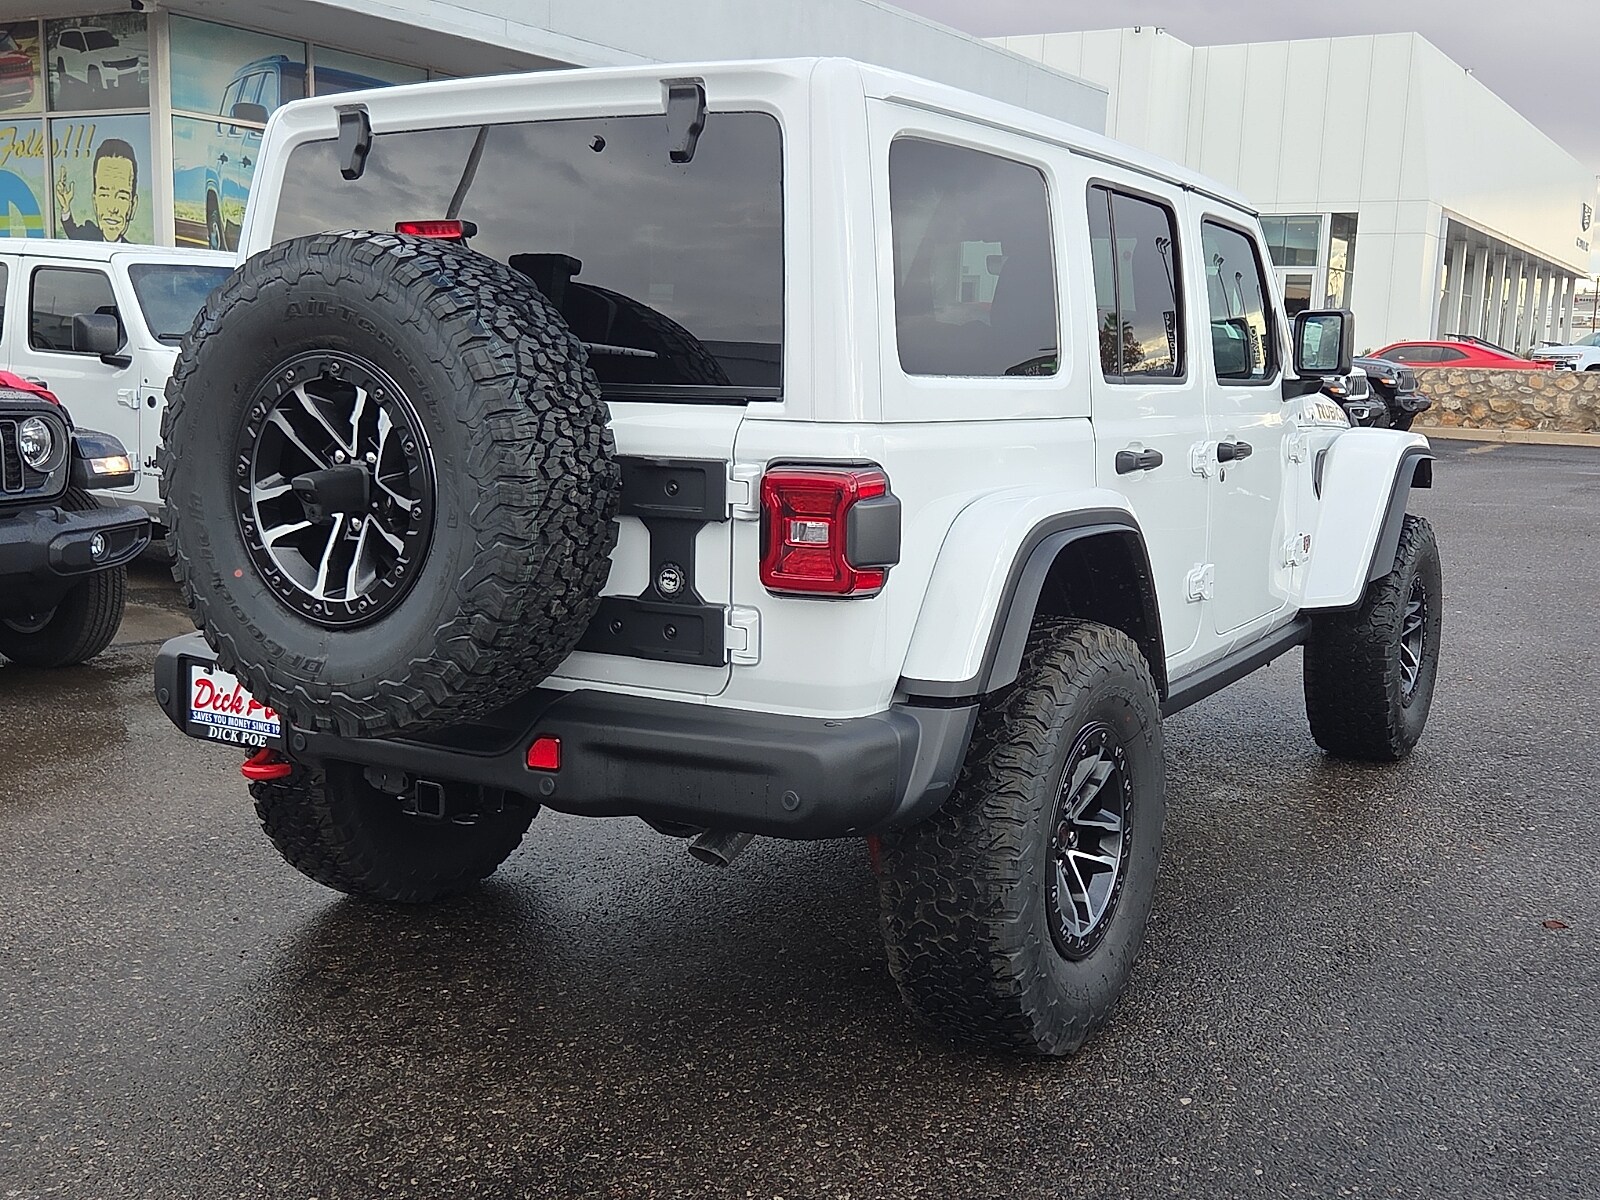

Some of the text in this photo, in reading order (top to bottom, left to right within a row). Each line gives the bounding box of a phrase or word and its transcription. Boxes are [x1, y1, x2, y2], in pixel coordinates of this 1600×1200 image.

[194, 678, 244, 715] Dick
[192, 711, 213, 722] SAVES
[213, 714, 227, 725] YOU
[227, 716, 251, 729] MONEY
[251, 720, 271, 733] SINCE
[208, 726, 267, 748] DICK POE
